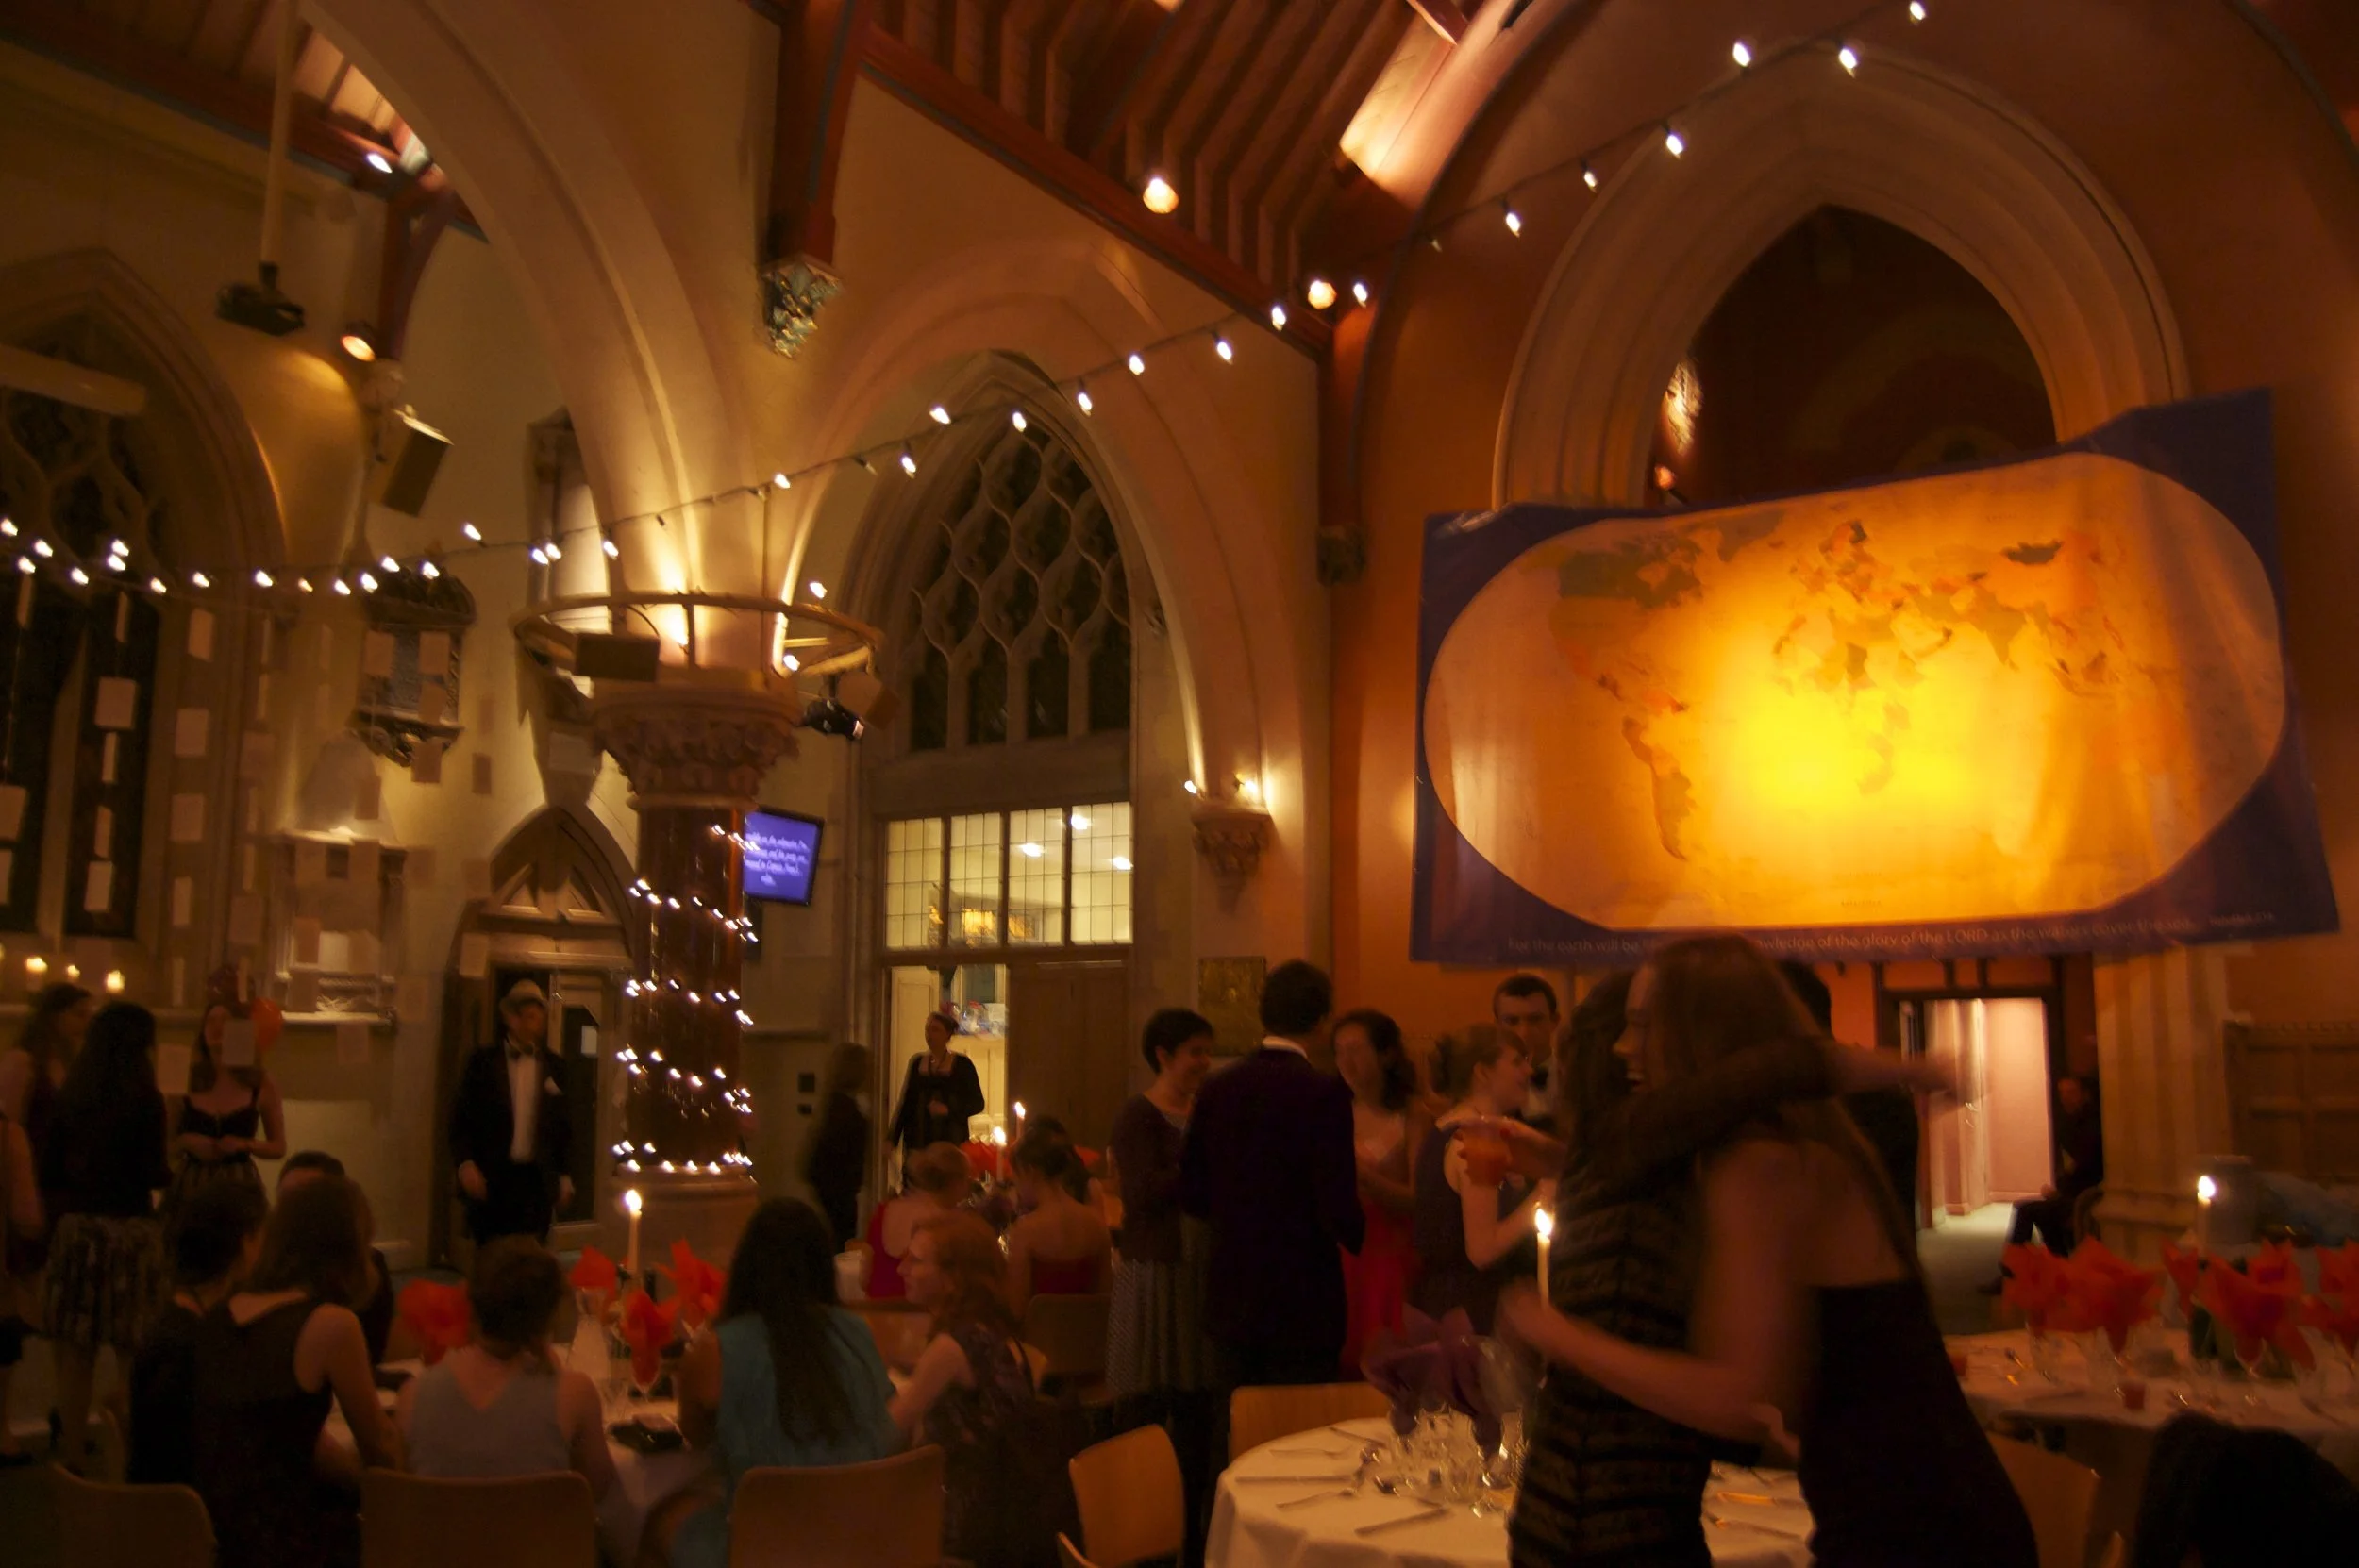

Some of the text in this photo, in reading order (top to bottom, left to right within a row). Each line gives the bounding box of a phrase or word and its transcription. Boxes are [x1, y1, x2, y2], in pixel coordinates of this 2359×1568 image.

[1532, 938, 1553, 952] the
[1557, 938, 1592, 953] earth
[1596, 937, 1618, 953] will
[1817, 933, 1832, 948] of
[1835, 932, 1859, 949] the
[1862, 931, 1897, 952] glory
[1900, 930, 1915, 947] of
[1918, 928, 1942, 946] the
[1946, 928, 1988, 946] LORD
[2010, 926, 2034, 943] the
